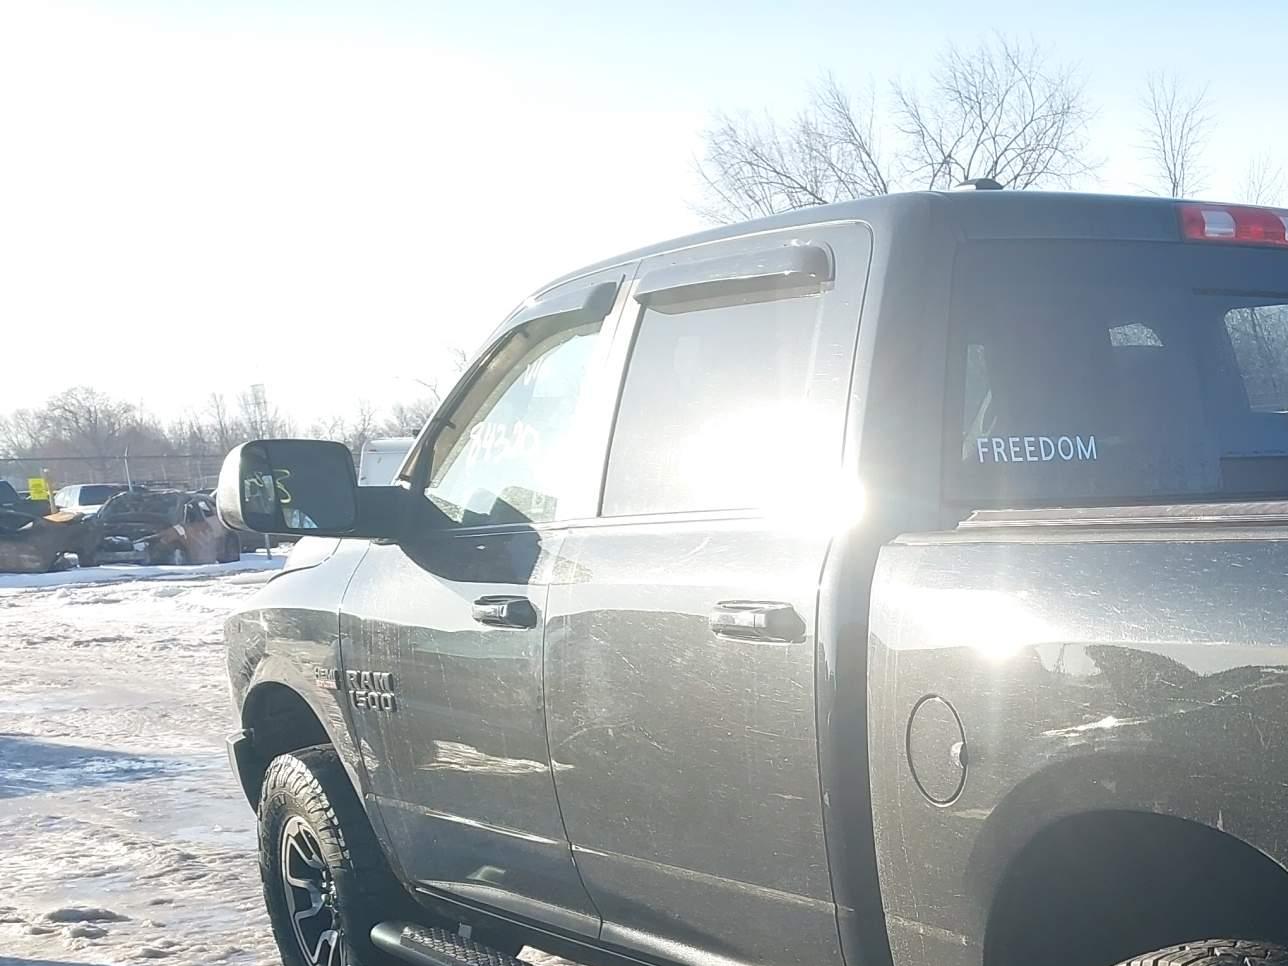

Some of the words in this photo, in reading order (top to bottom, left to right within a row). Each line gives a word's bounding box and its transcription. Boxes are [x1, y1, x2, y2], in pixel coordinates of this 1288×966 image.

[977, 436, 1097, 463] FREEDOM
[346, 669, 393, 692] RAM
[348, 690, 397, 712] 1500
